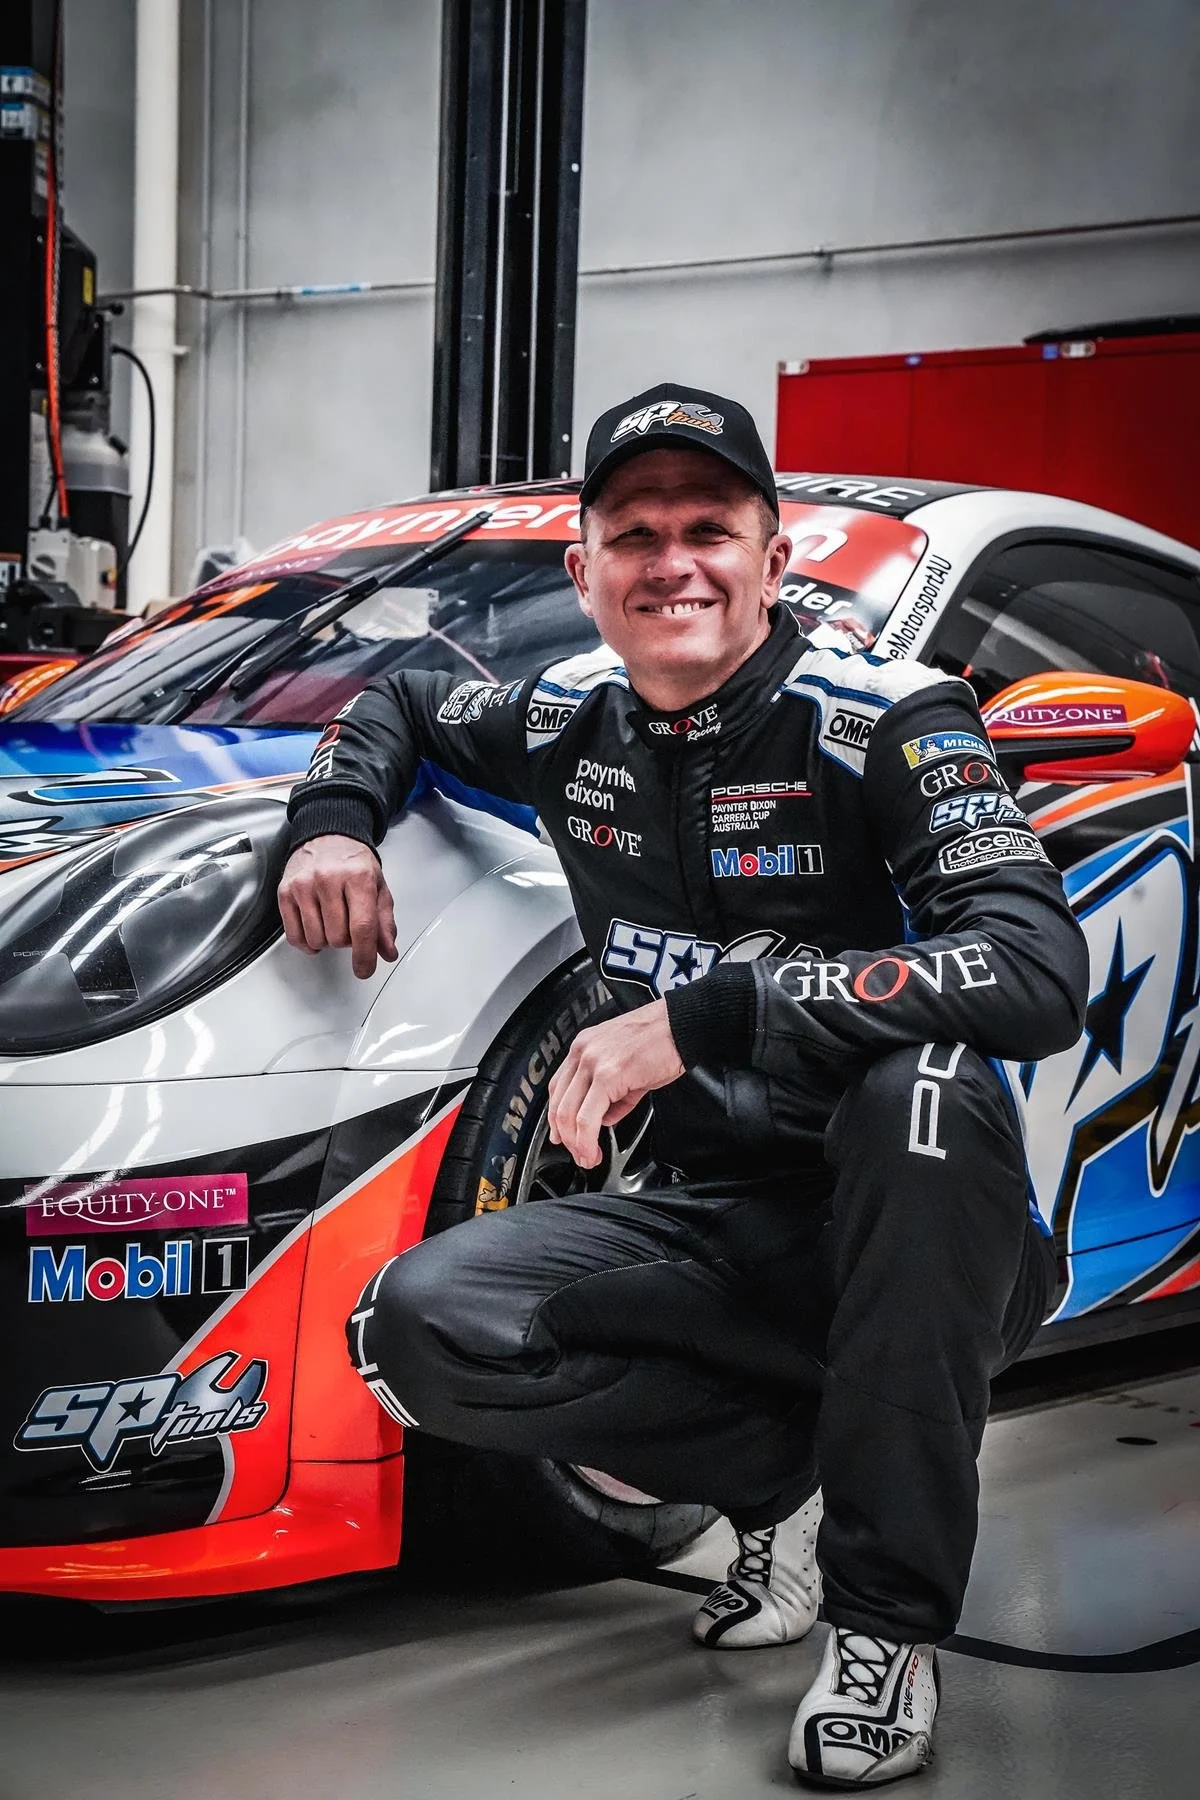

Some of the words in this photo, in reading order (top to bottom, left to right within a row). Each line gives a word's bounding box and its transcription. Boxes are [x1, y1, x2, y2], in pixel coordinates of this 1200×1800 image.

[612, 401, 682, 441] SP
[527, 706, 574, 729] OMP
[687, 721, 722, 742] Racing
[829, 714, 872, 745] OMP
[565, 780, 614, 811] dixon
[711, 781, 807, 798] PORSCHE
[711, 802, 748, 813] PAYNTER
[750, 800, 776, 810] DIXON
[712, 812, 751, 823] CARRERA
[753, 810, 770, 820] CUP
[713, 821, 760, 832] AUSTRALIA
[711, 845, 795, 877] Mobil
[950, 850, 1007, 869] motorsport
[28, 1240, 193, 1302] Mobil
[22, 1375, 178, 1463] SP
[151, 1398, 267, 1450] tools
